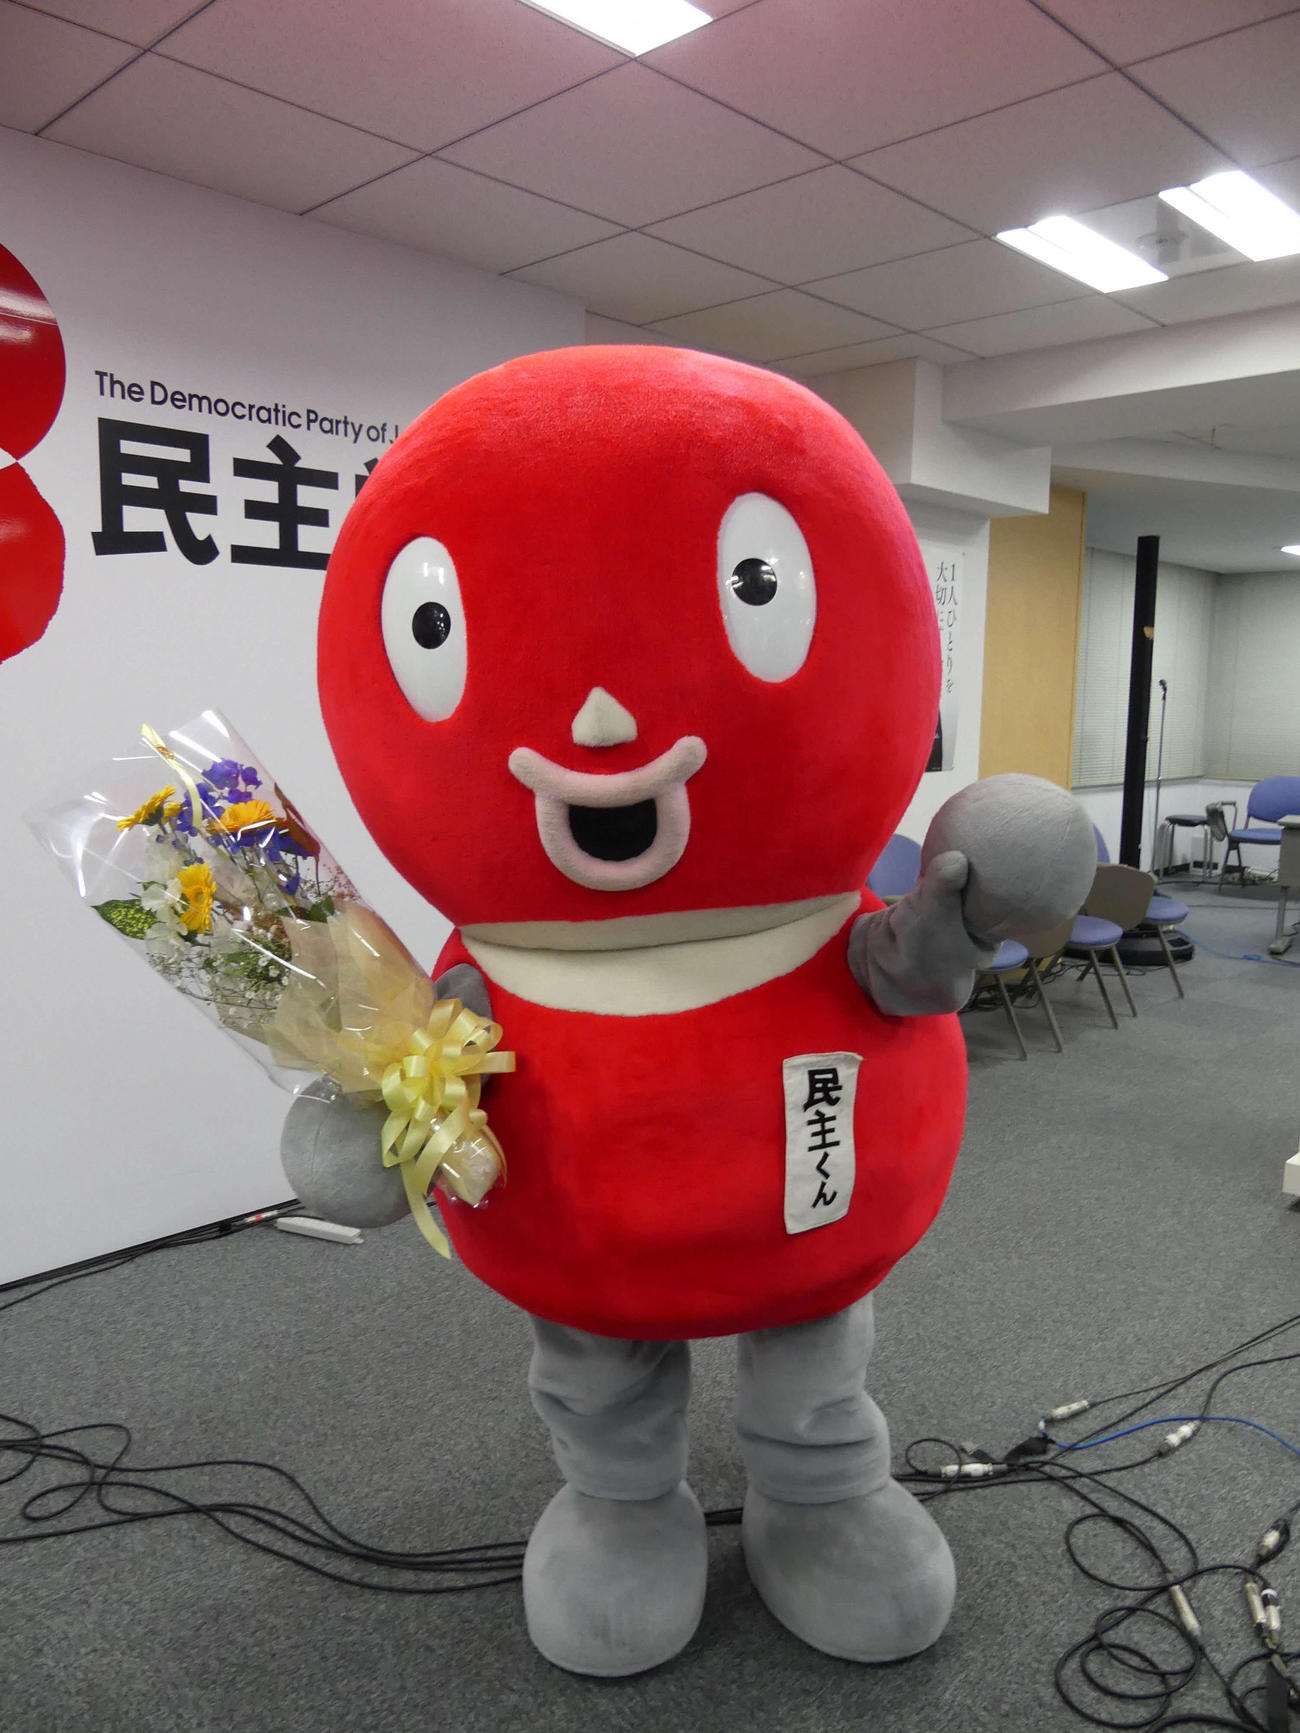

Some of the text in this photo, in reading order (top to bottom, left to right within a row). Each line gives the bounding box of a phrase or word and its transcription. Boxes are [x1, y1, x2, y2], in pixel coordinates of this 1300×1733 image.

[95, 370, 145, 402] The
[150, 381, 302, 429] Democratic
[306, 409, 363, 444] Party
[366, 422, 387, 443] of
[91, 417, 379, 571] 民主
[803, 1067, 843, 1208] 民主くん
